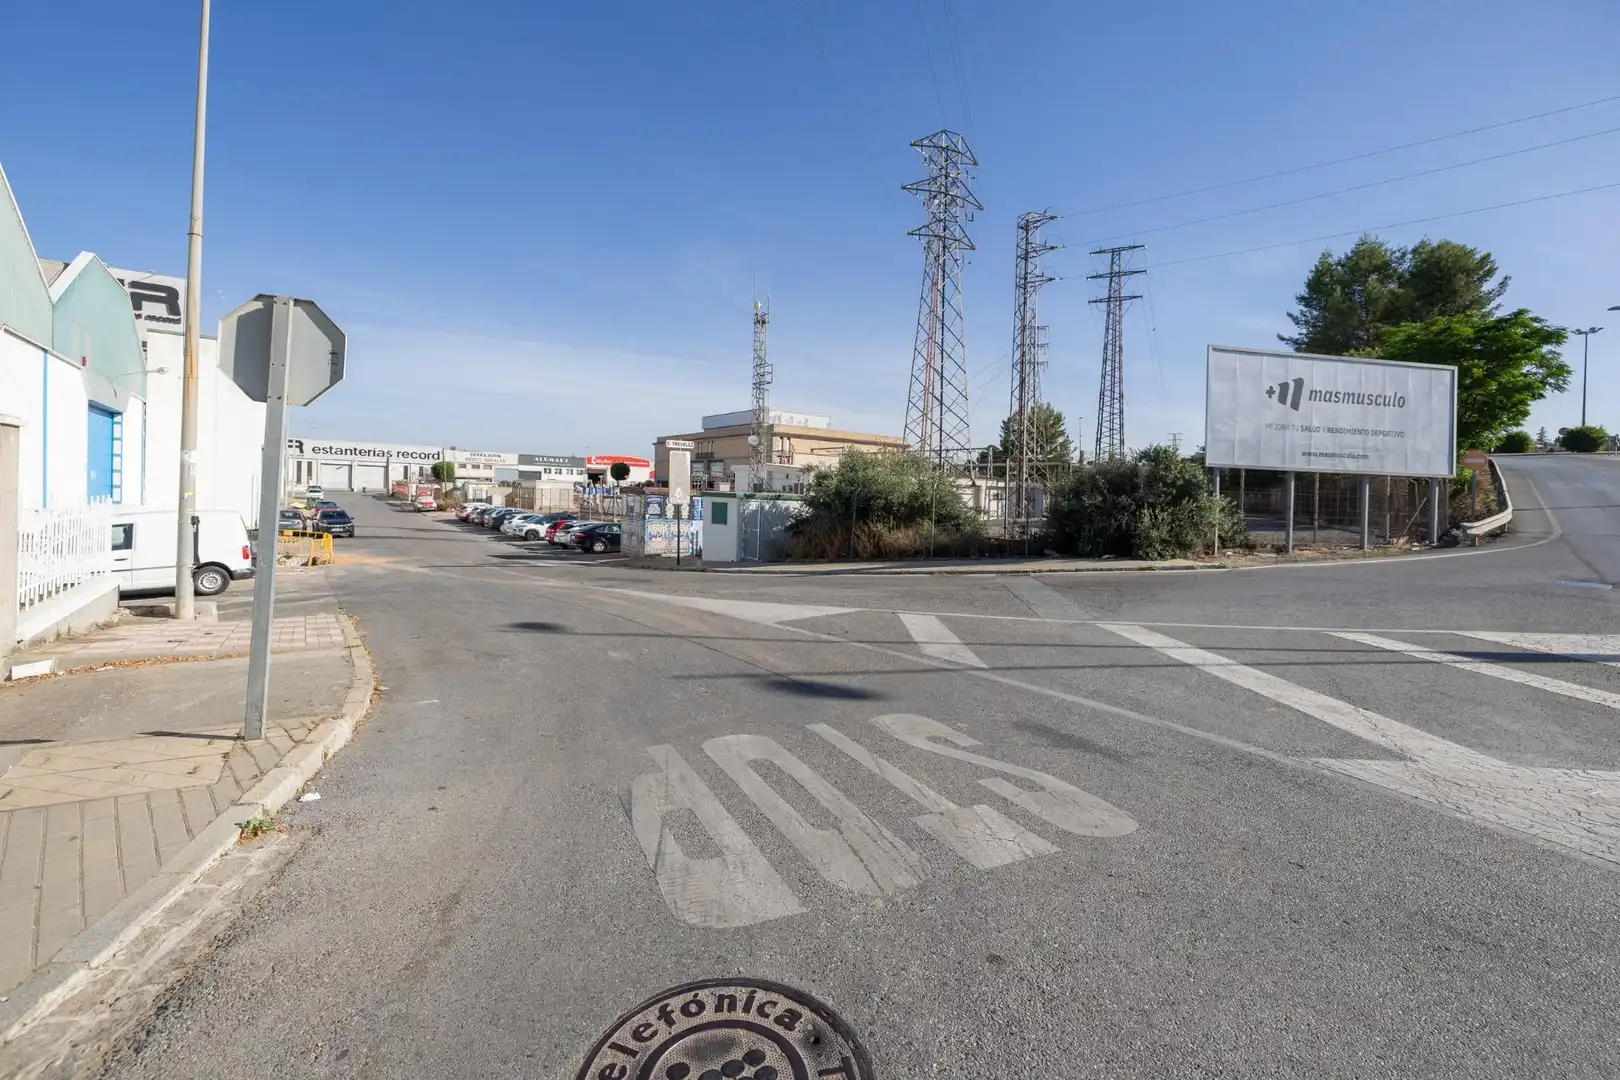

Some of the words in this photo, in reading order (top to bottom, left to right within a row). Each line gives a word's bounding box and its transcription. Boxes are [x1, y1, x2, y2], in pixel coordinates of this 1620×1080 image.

[1308, 387, 1406, 408] masmusculo
[1300, 424, 1321, 433] SALUD
[1326, 427, 1370, 436] RENDIMIENTO
[1370, 429, 1405, 438] DEPORTIVO
[396, 451, 441, 461] record
[630, 713, 1140, 930] STOP
[596, 988, 804, 1080] elefónica
